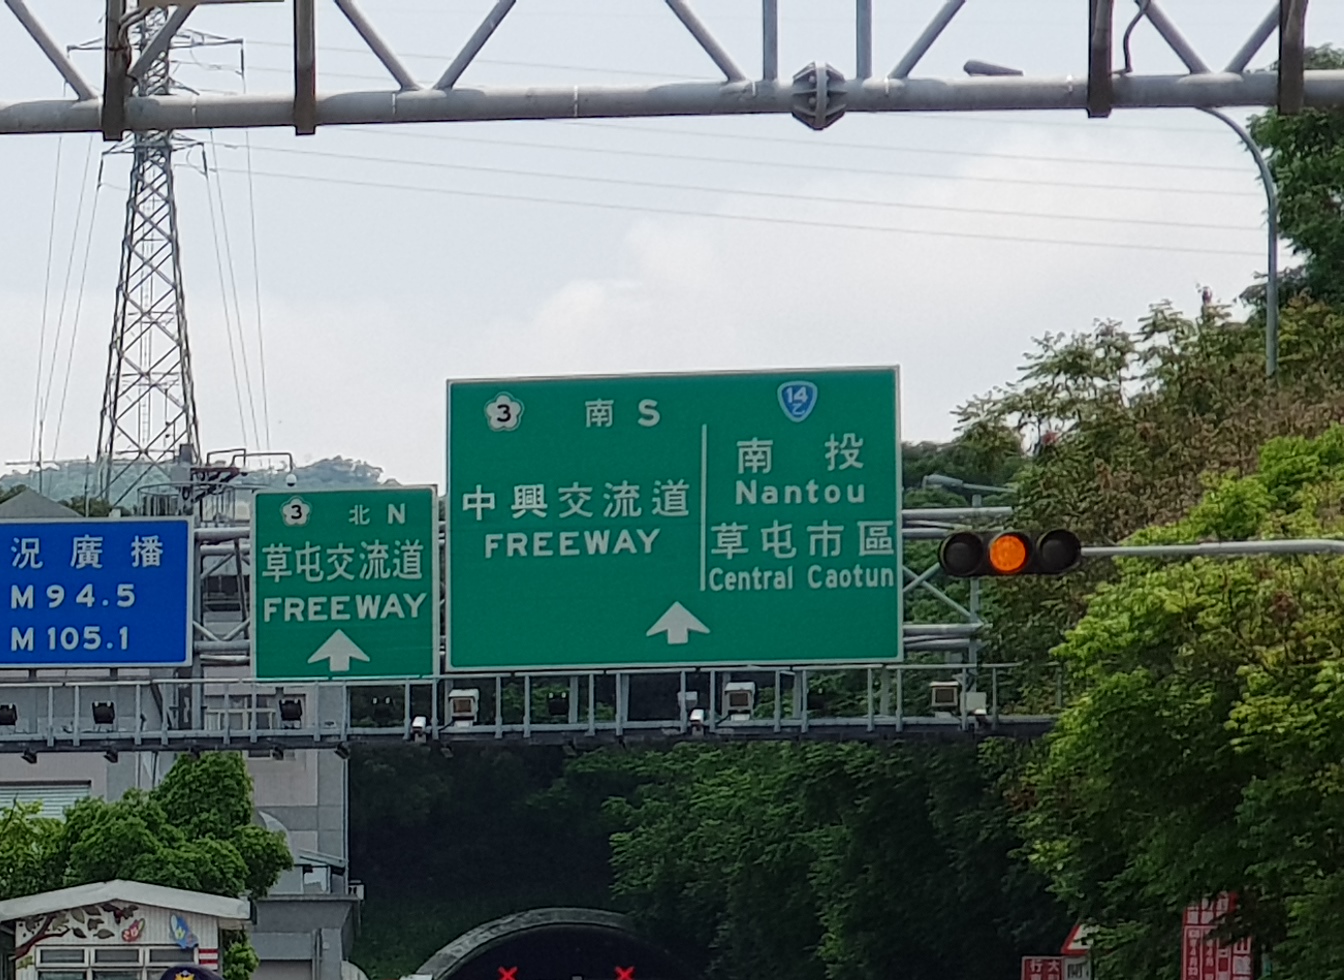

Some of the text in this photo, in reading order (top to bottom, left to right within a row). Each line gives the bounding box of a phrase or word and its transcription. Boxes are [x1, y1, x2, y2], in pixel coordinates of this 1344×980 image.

[785, 386, 808, 403] 14
[496, 404, 512, 422] 3
[584, 398, 661, 428] 南 S
[791, 403, 806, 416] 乙
[736, 433, 864, 474] 南投
[462, 479, 690, 521] 中興交流道
[735, 479, 865, 505] Nantou
[290, 504, 302, 520] 3
[348, 503, 406, 526] 北 N
[484, 528, 661, 558] FREEWAY
[710, 519, 894, 559] 草屯市區
[262, 539, 424, 583] 草屯交流道
[708, 563, 894, 592] Central Caotun
[263, 592, 428, 622] FREEWAY
